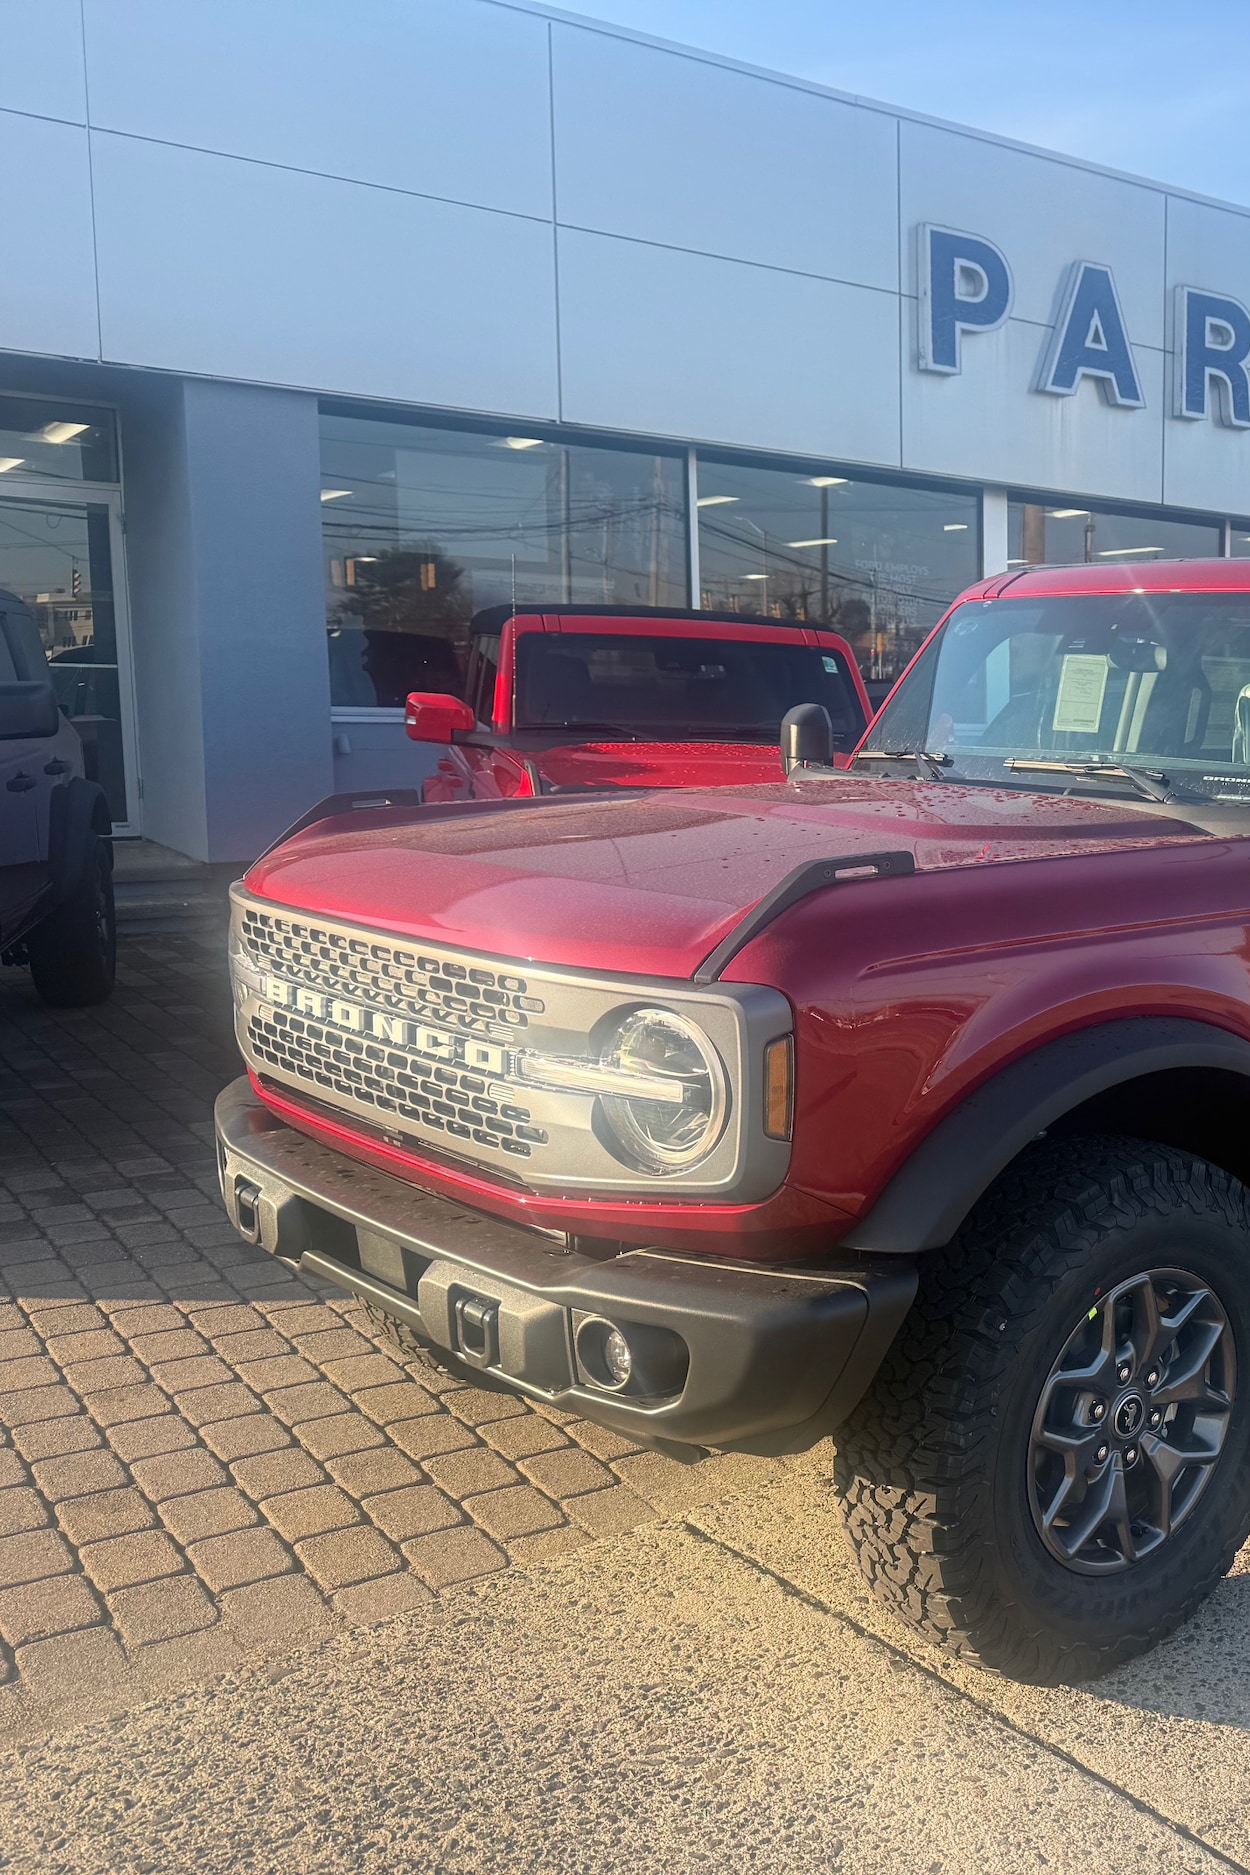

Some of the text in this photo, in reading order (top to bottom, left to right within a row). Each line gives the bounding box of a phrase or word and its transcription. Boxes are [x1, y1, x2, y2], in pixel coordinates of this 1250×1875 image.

[885, 562, 929, 576] EMPLOYS
[890, 573, 917, 585] MOST
[266, 975, 507, 1075] BRONCO
